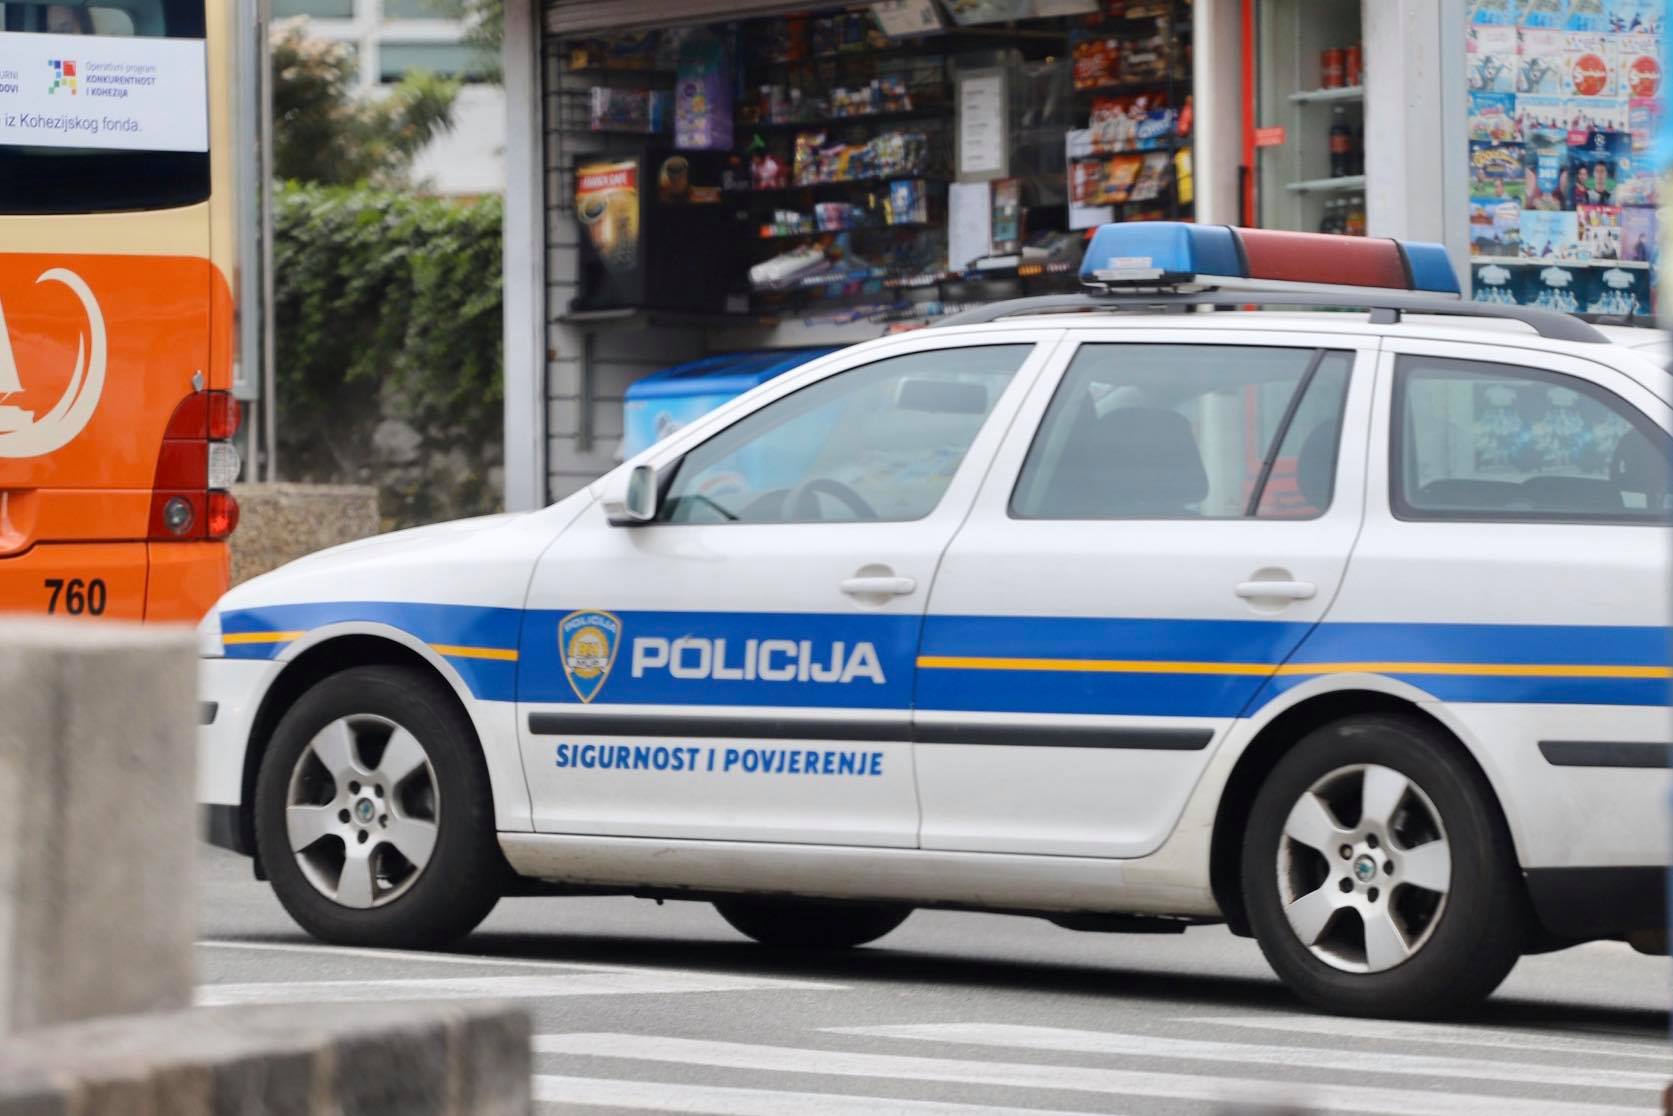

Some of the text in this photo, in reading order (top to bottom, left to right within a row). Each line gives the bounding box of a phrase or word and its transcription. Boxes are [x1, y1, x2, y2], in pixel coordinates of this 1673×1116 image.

[86, 61, 156, 74] Operativni program
[86, 75, 156, 86] KONKURENTNOST
[91, 87, 128, 98] KOHEZIJA
[5, 113, 142, 134] iz Kohezijskog fonda.
[44, 578, 107, 616] 760
[564, 614, 617, 633] POLICIJA
[632, 636, 886, 684] POLICIJA
[556, 743, 884, 776] SIGURNOST I POVJERENJE
